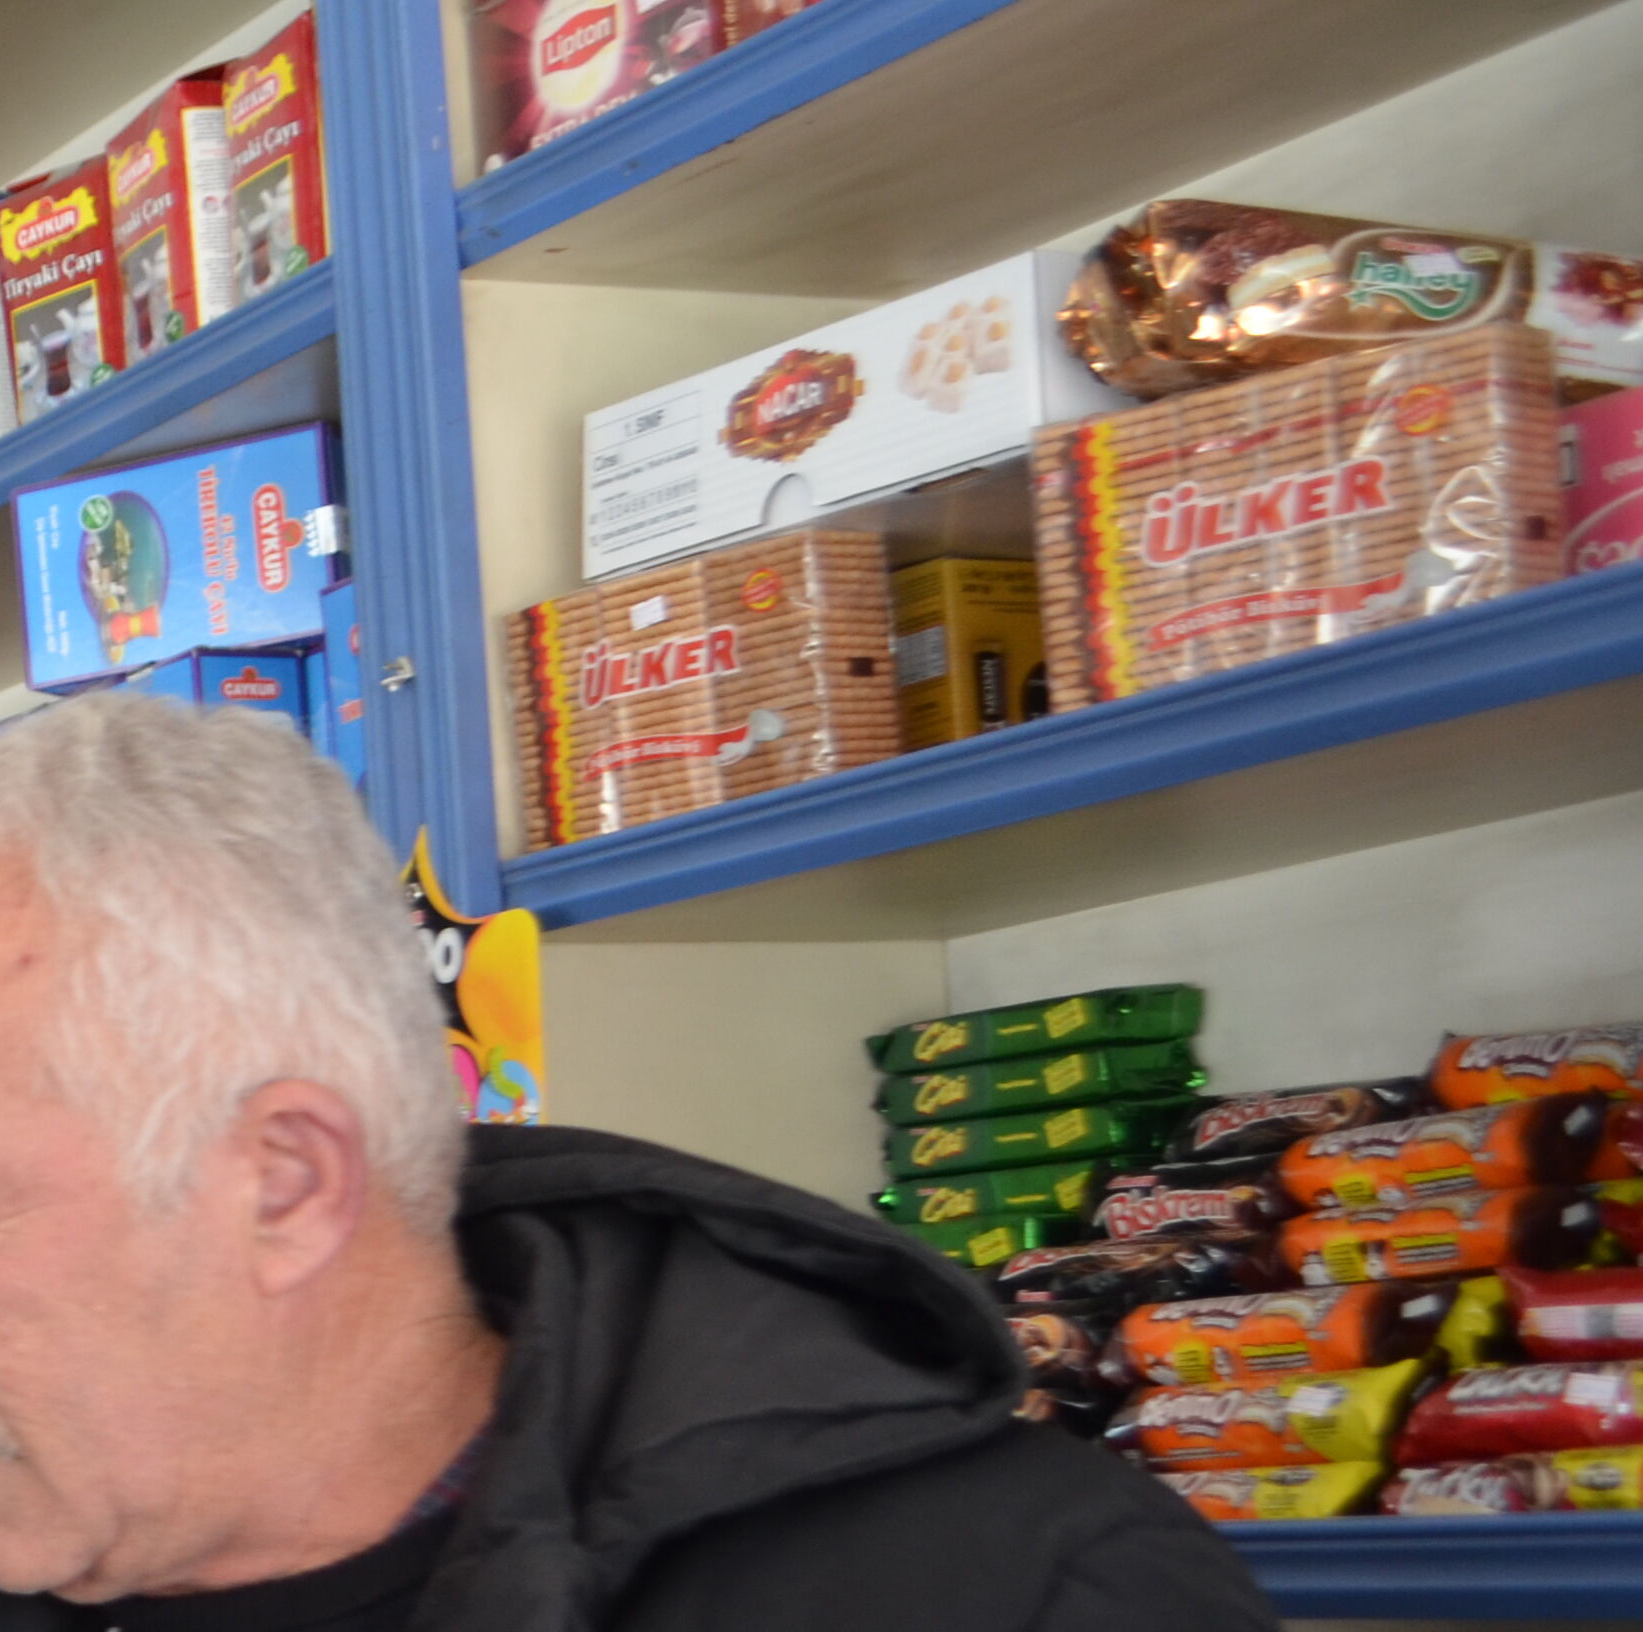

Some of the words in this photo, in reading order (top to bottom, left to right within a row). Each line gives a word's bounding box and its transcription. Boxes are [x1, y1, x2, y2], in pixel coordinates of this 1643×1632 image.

[546, 17, 614, 66] Lipton
[1145, 458, 1388, 566] ÜLKER
[581, 626, 740, 709] ÜLKER
